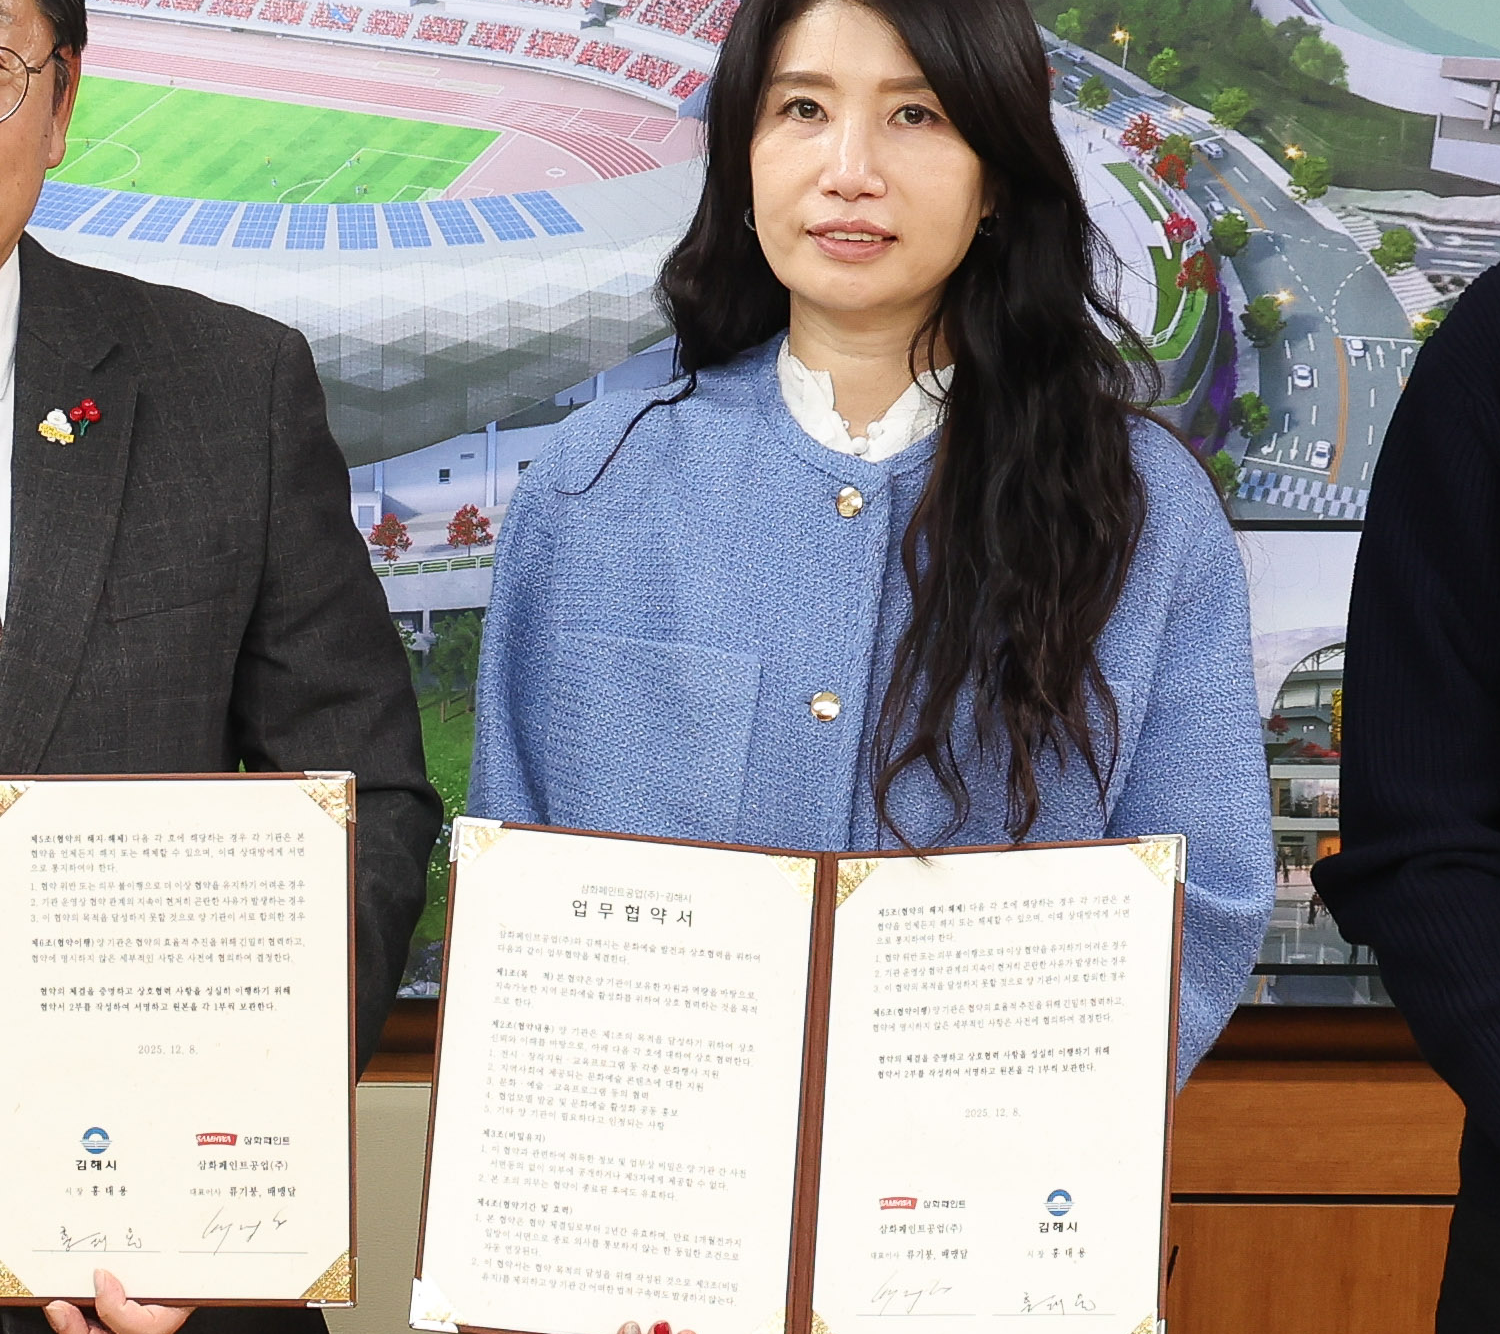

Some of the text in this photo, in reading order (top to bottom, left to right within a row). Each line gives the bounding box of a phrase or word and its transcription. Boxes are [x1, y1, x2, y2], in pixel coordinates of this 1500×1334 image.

[138, 1045, 198, 1055] 2025. 12. 8.
[965, 1108, 1022, 1118] 2025. 12. 8.
[75, 1160, 117, 1171] 김해시
[197, 1161, 288, 1171] 삼화페인트공업(주)
[1038, 1222, 1078, 1233] 김해시
